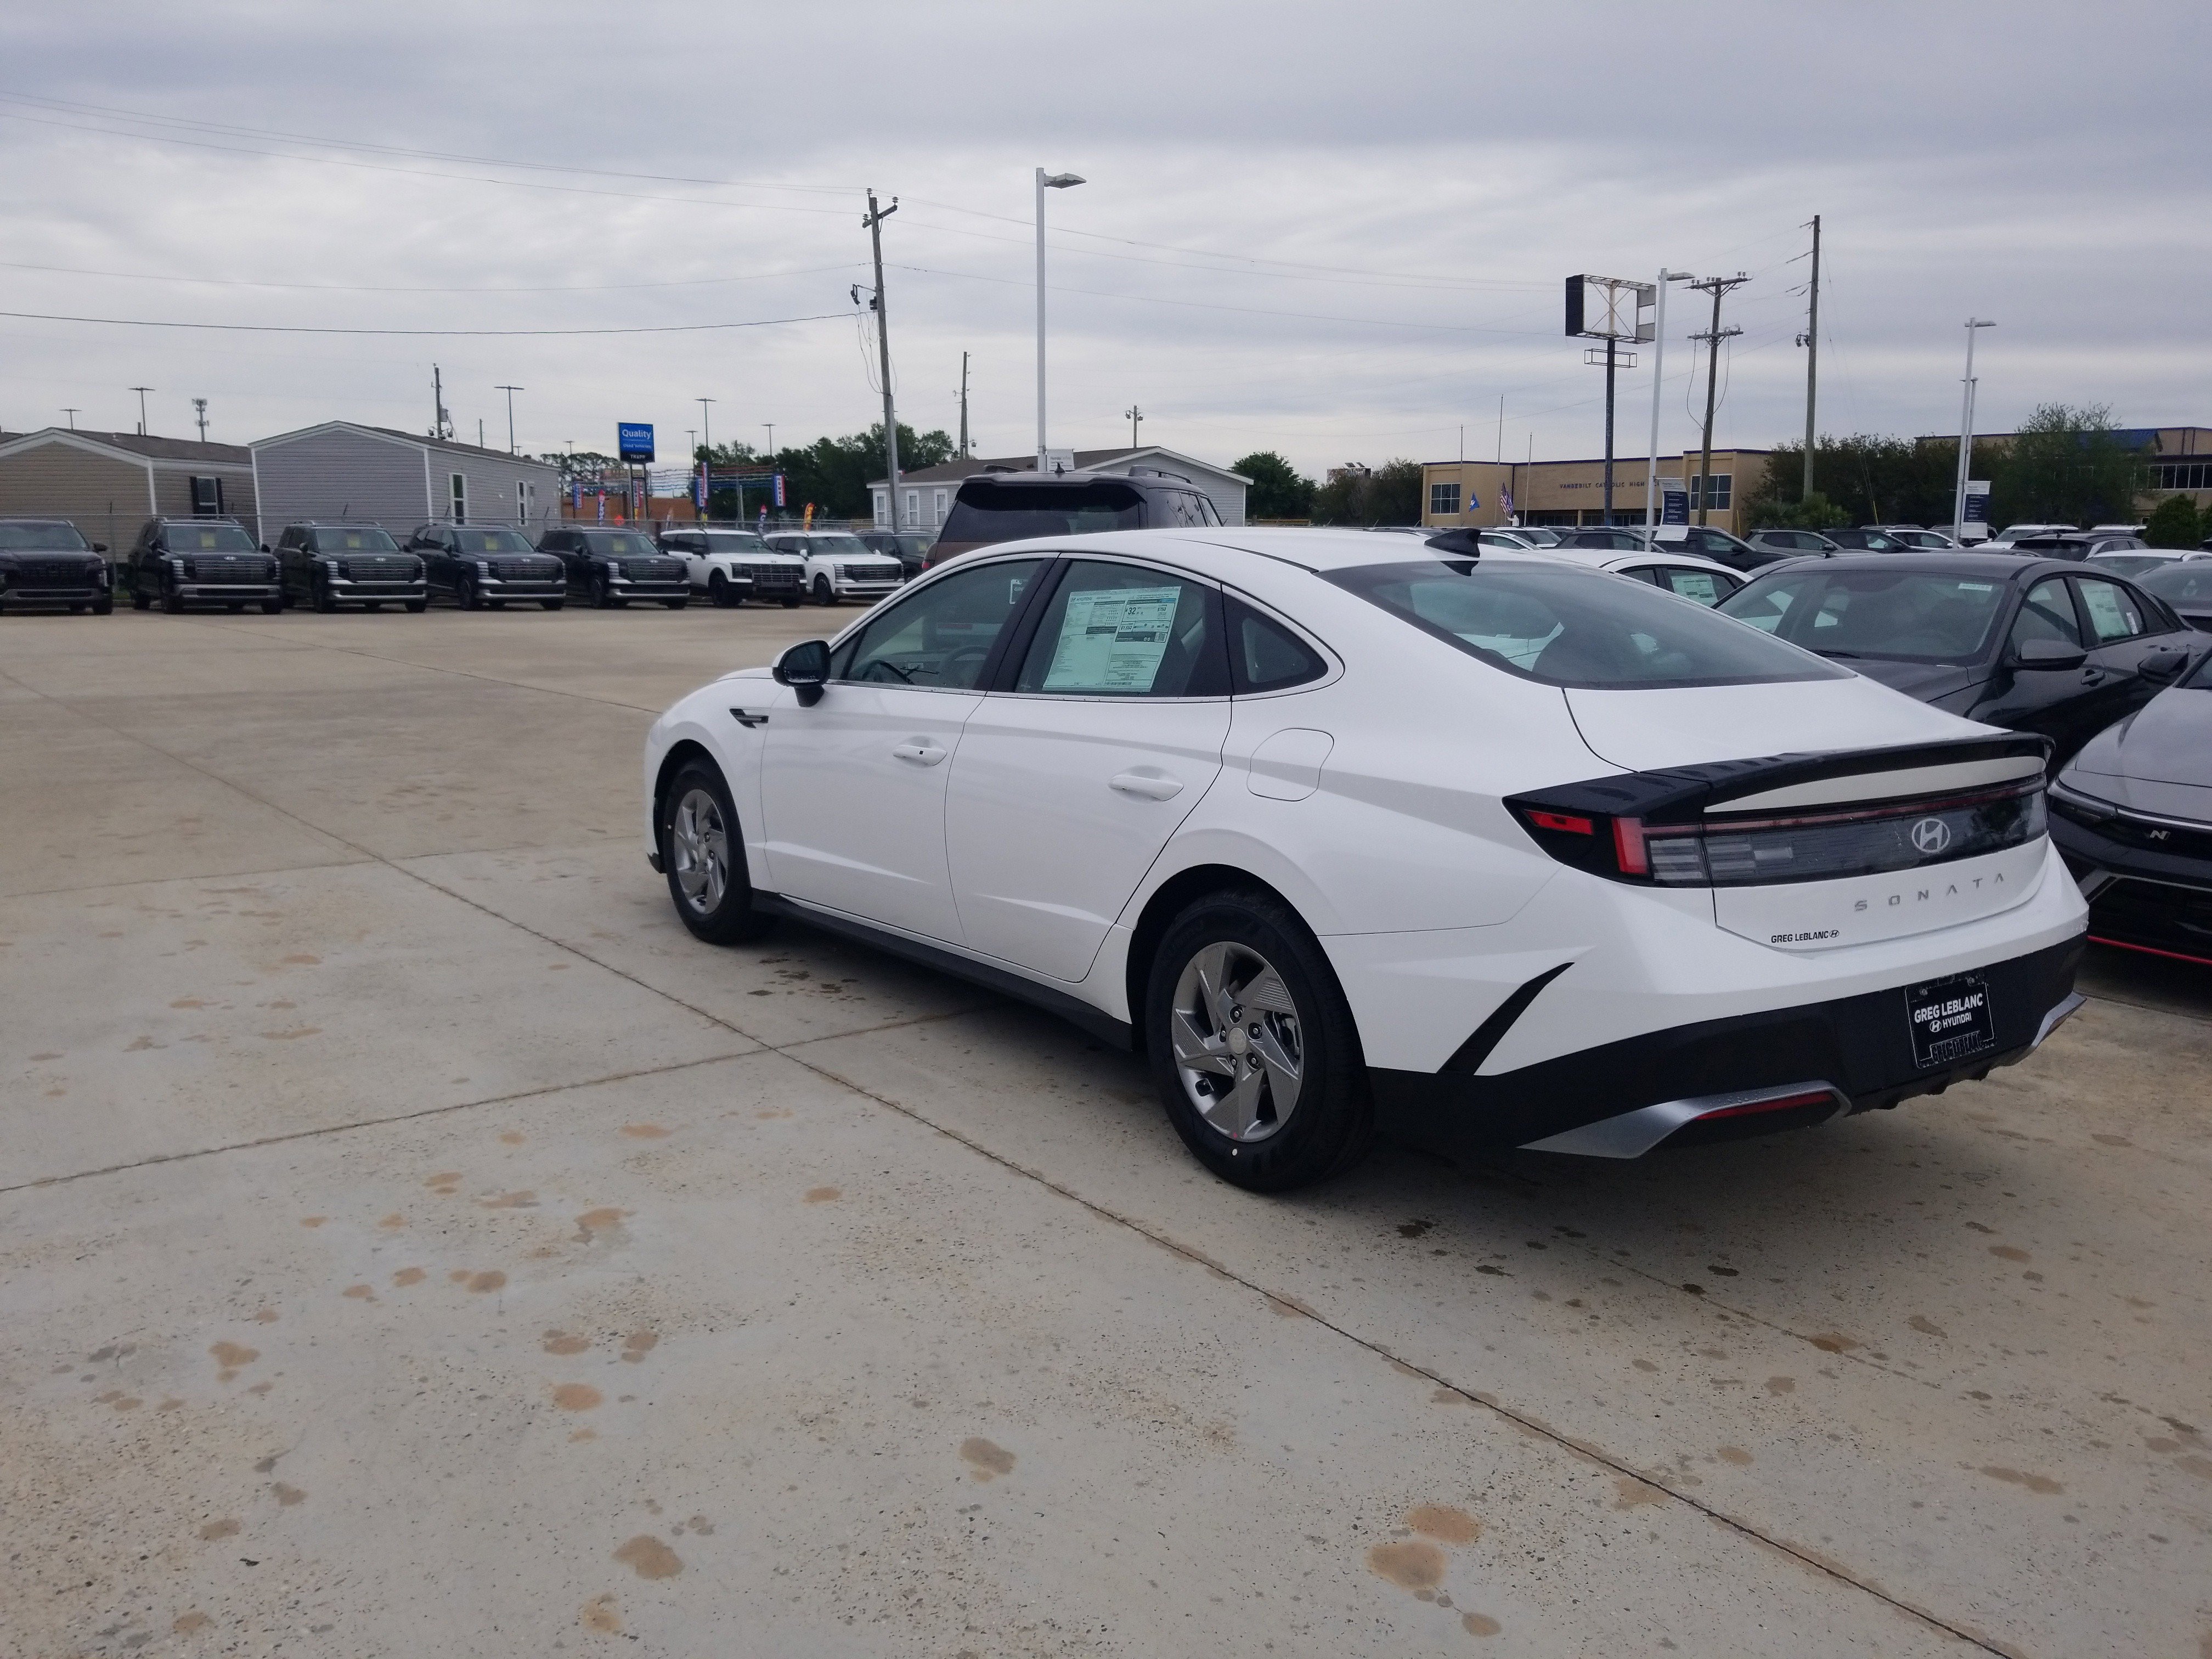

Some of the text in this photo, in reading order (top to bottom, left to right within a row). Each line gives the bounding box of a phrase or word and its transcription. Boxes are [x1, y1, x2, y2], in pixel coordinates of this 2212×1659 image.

[622, 429, 651, 440] Quality
[1854, 873, 2004, 912] SONATA
[1771, 934, 1793, 943] GREG
[1914, 993, 1983, 1023] GREG LEBLANC
[1943, 1012, 1972, 1029] HYUNDAI
